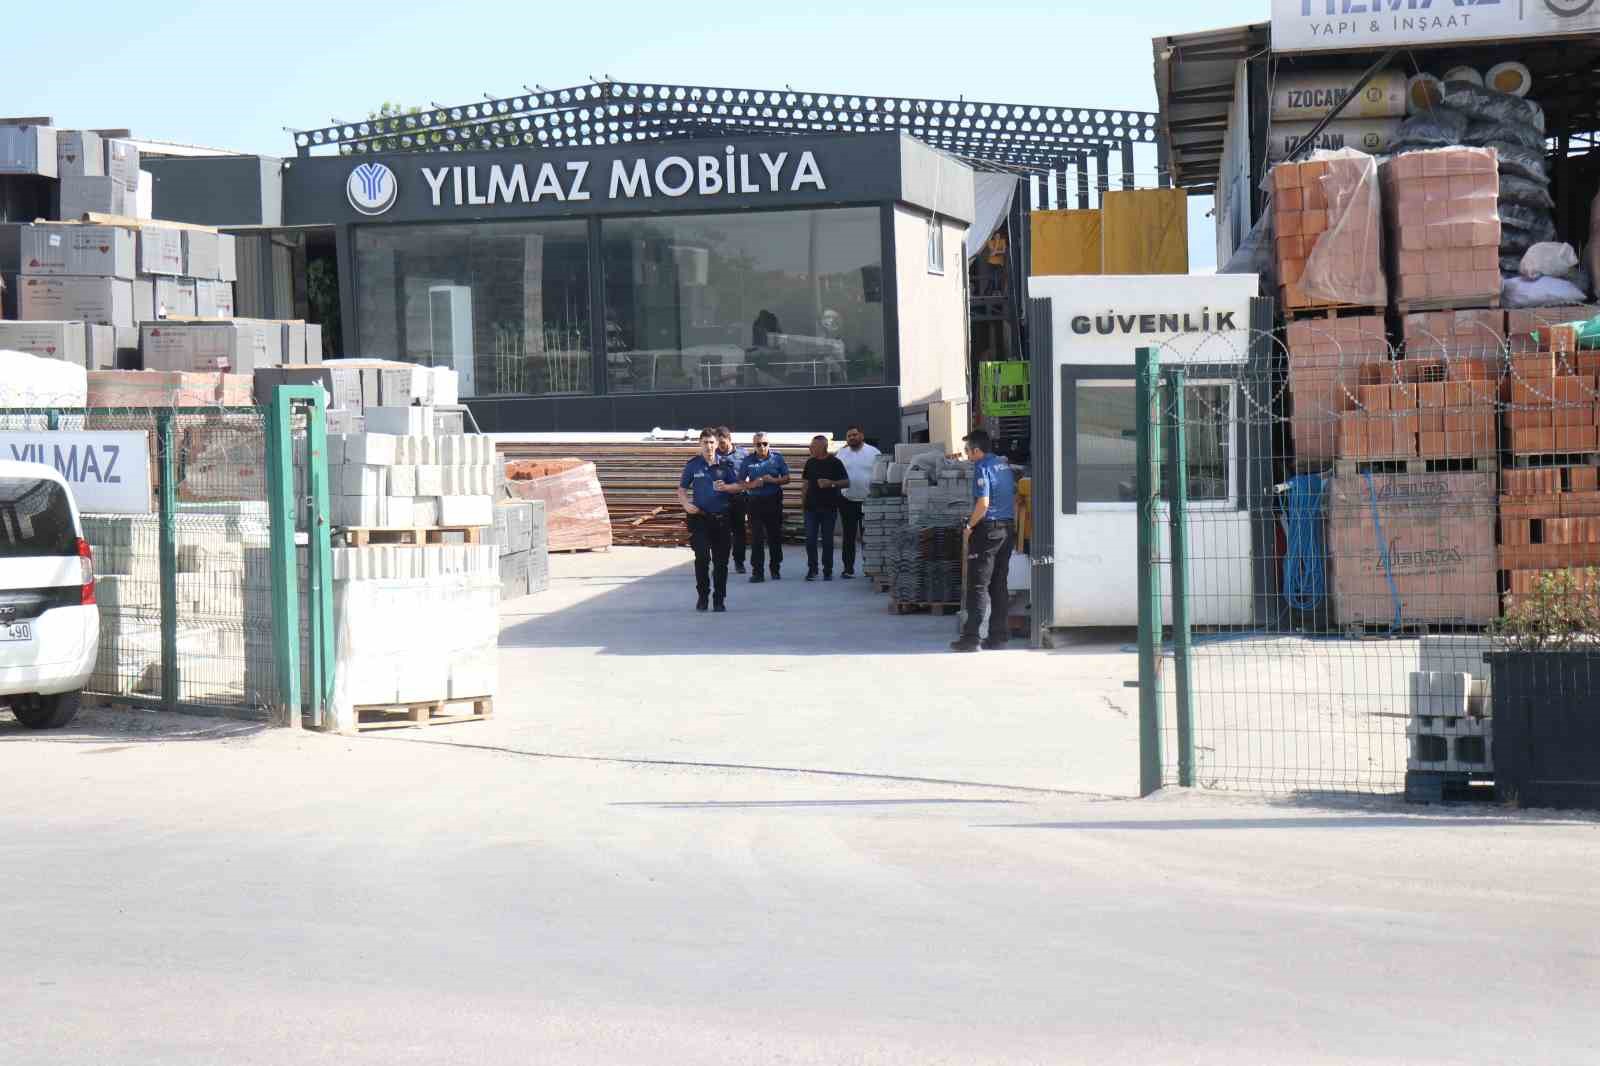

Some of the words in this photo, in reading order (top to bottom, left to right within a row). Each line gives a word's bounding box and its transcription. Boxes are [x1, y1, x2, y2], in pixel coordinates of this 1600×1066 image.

[1310, 23, 1356, 35] YAPI
[1369, 19, 1380, 32] &
[1393, 14, 1472, 32] İNŞAAT
[421, 160, 591, 207] YILMAZ
[608, 145, 827, 199] MOBİLYA
[1070, 306, 1238, 335] GÜVENLİK
